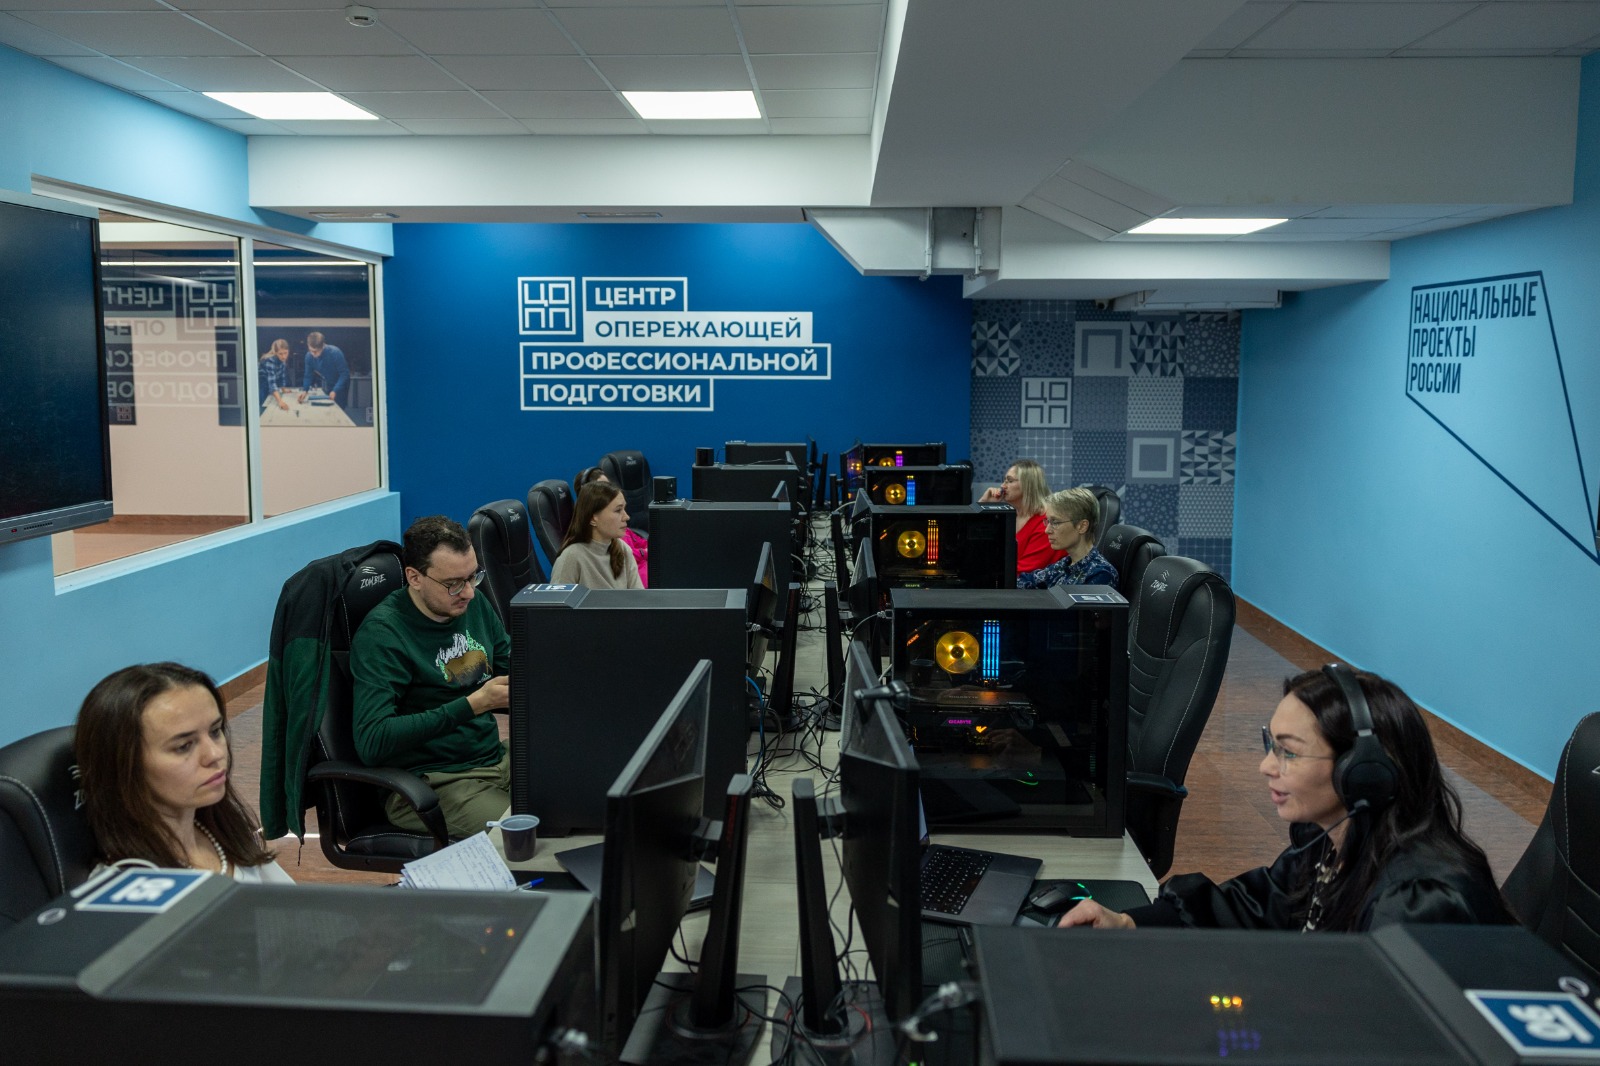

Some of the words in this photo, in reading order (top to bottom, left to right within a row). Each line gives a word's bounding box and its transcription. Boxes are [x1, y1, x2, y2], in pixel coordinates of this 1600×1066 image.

[594, 287, 676, 309] ЦЕНТР
[1413, 281, 1538, 326] НАЦИОНАЛЬНЫЕ
[595, 317, 802, 341] ОПЕРЕЖАЮЩЕЙ
[1411, 325, 1477, 357] ПРОЕКТЫ
[532, 349, 818, 372] ПРОФЕССИОНАЛЬНОЙ
[1409, 362, 1462, 394] РОССИИ
[532, 384, 702, 405] ПОДГОТОВКИ
[360, 573, 387, 590] ZOMBIE
